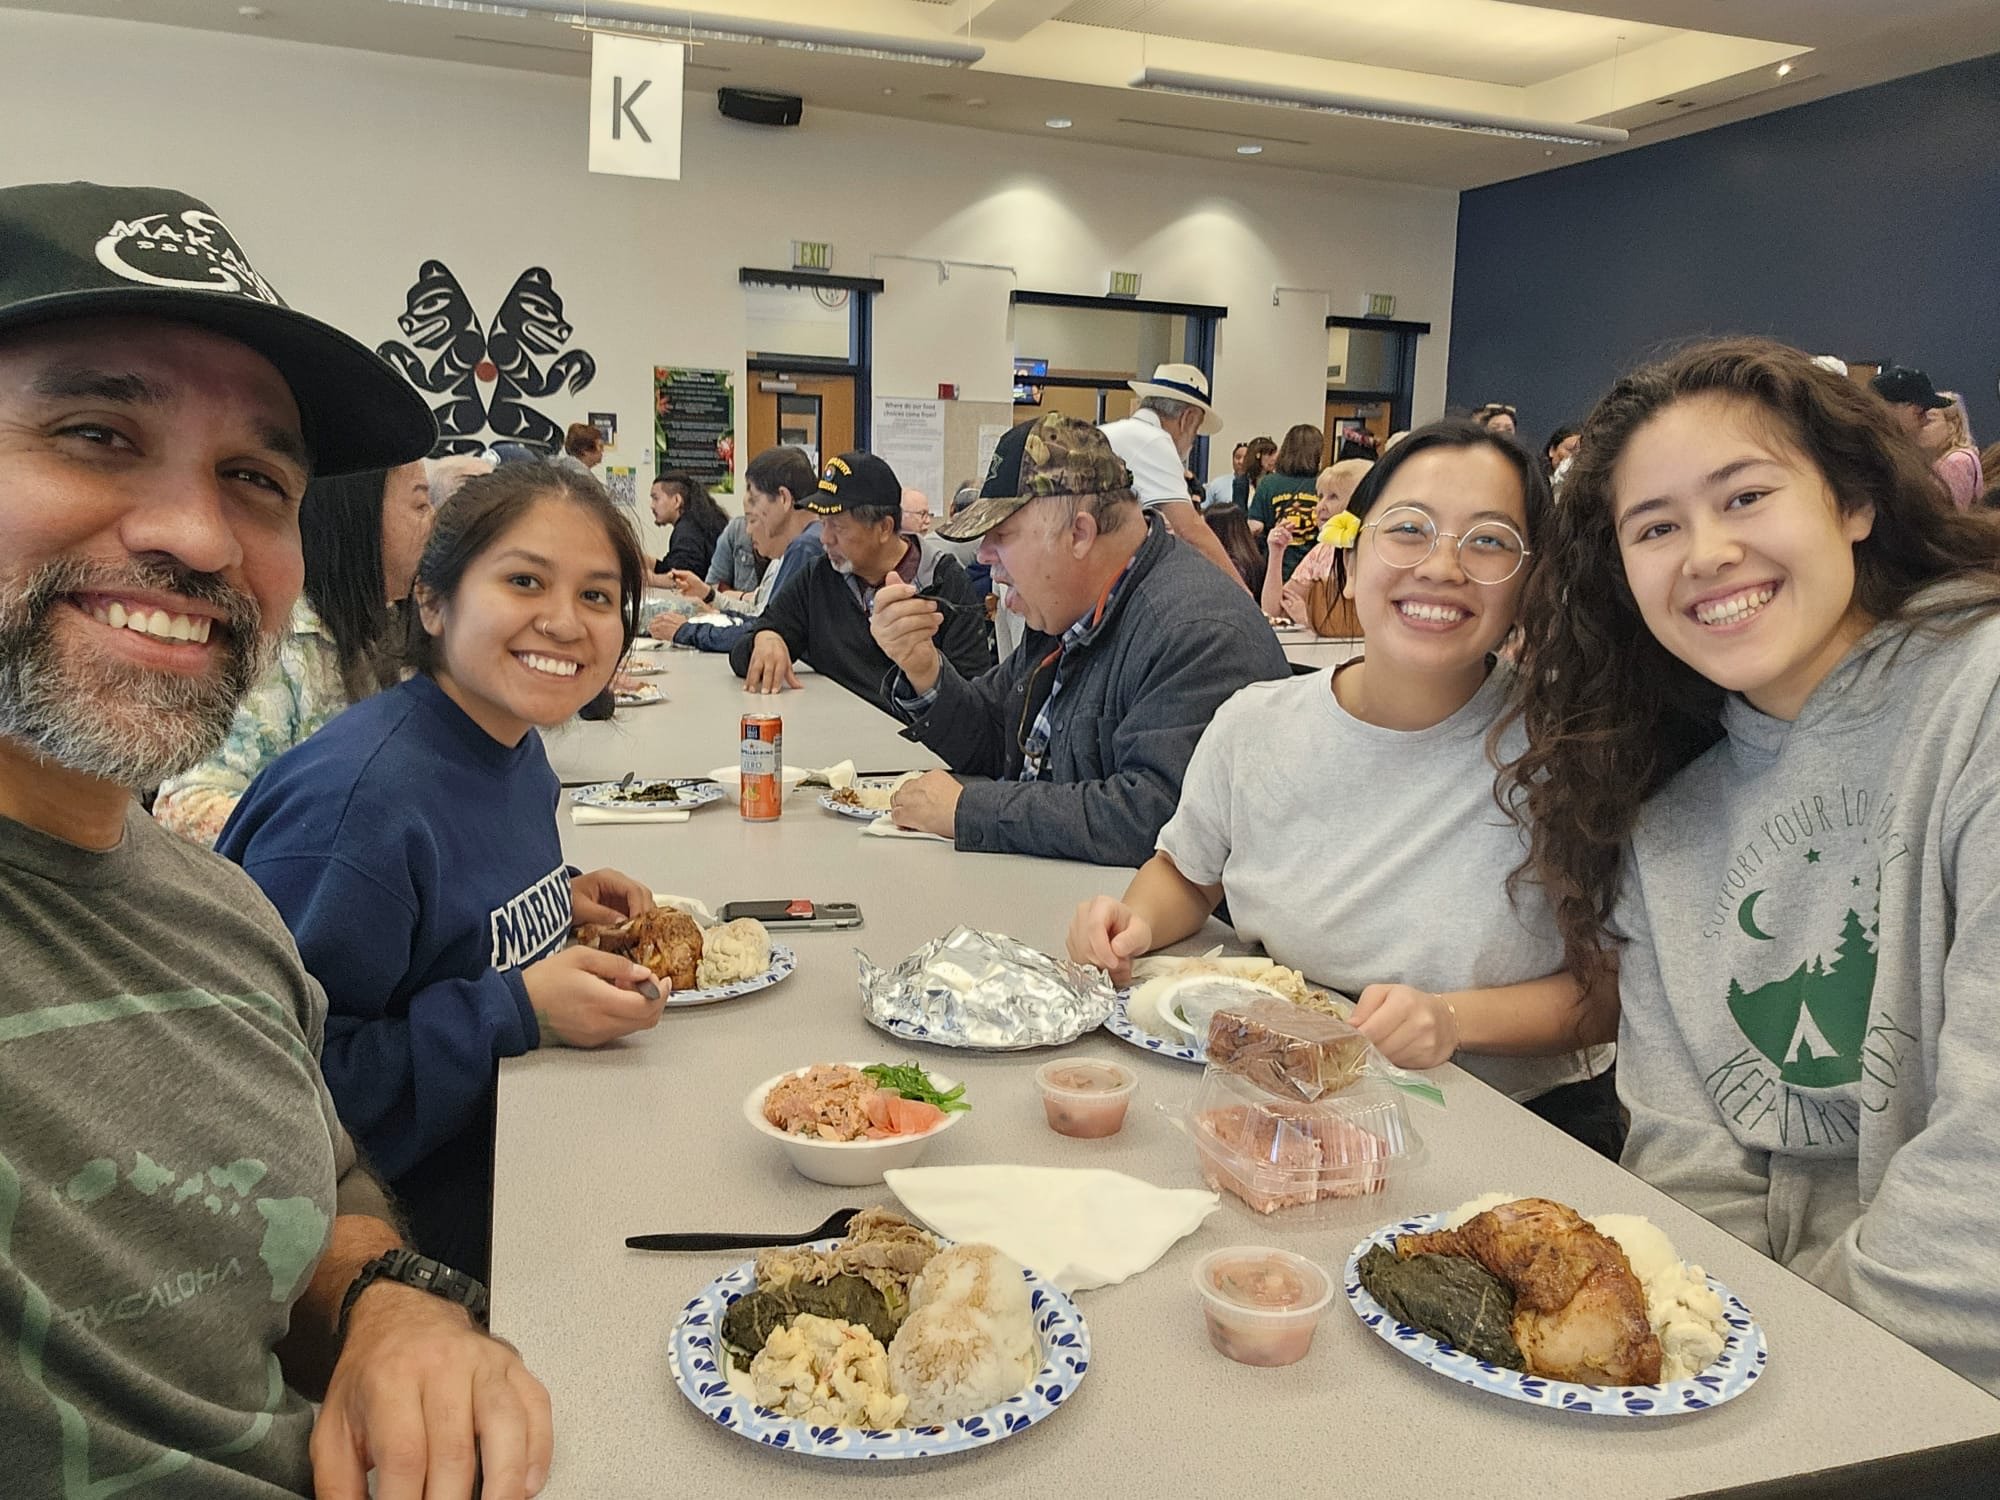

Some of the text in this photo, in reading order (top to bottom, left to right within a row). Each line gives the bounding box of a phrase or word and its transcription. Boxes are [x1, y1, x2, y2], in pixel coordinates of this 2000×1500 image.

[612, 76, 652, 143] K
[801, 241, 828, 267] EXIT
[1114, 272, 1138, 293] EXIT
[1372, 294, 1392, 314] EXIT
[1703, 841, 1764, 940] SUPPORT
[1760, 795, 1834, 852] YOUR
